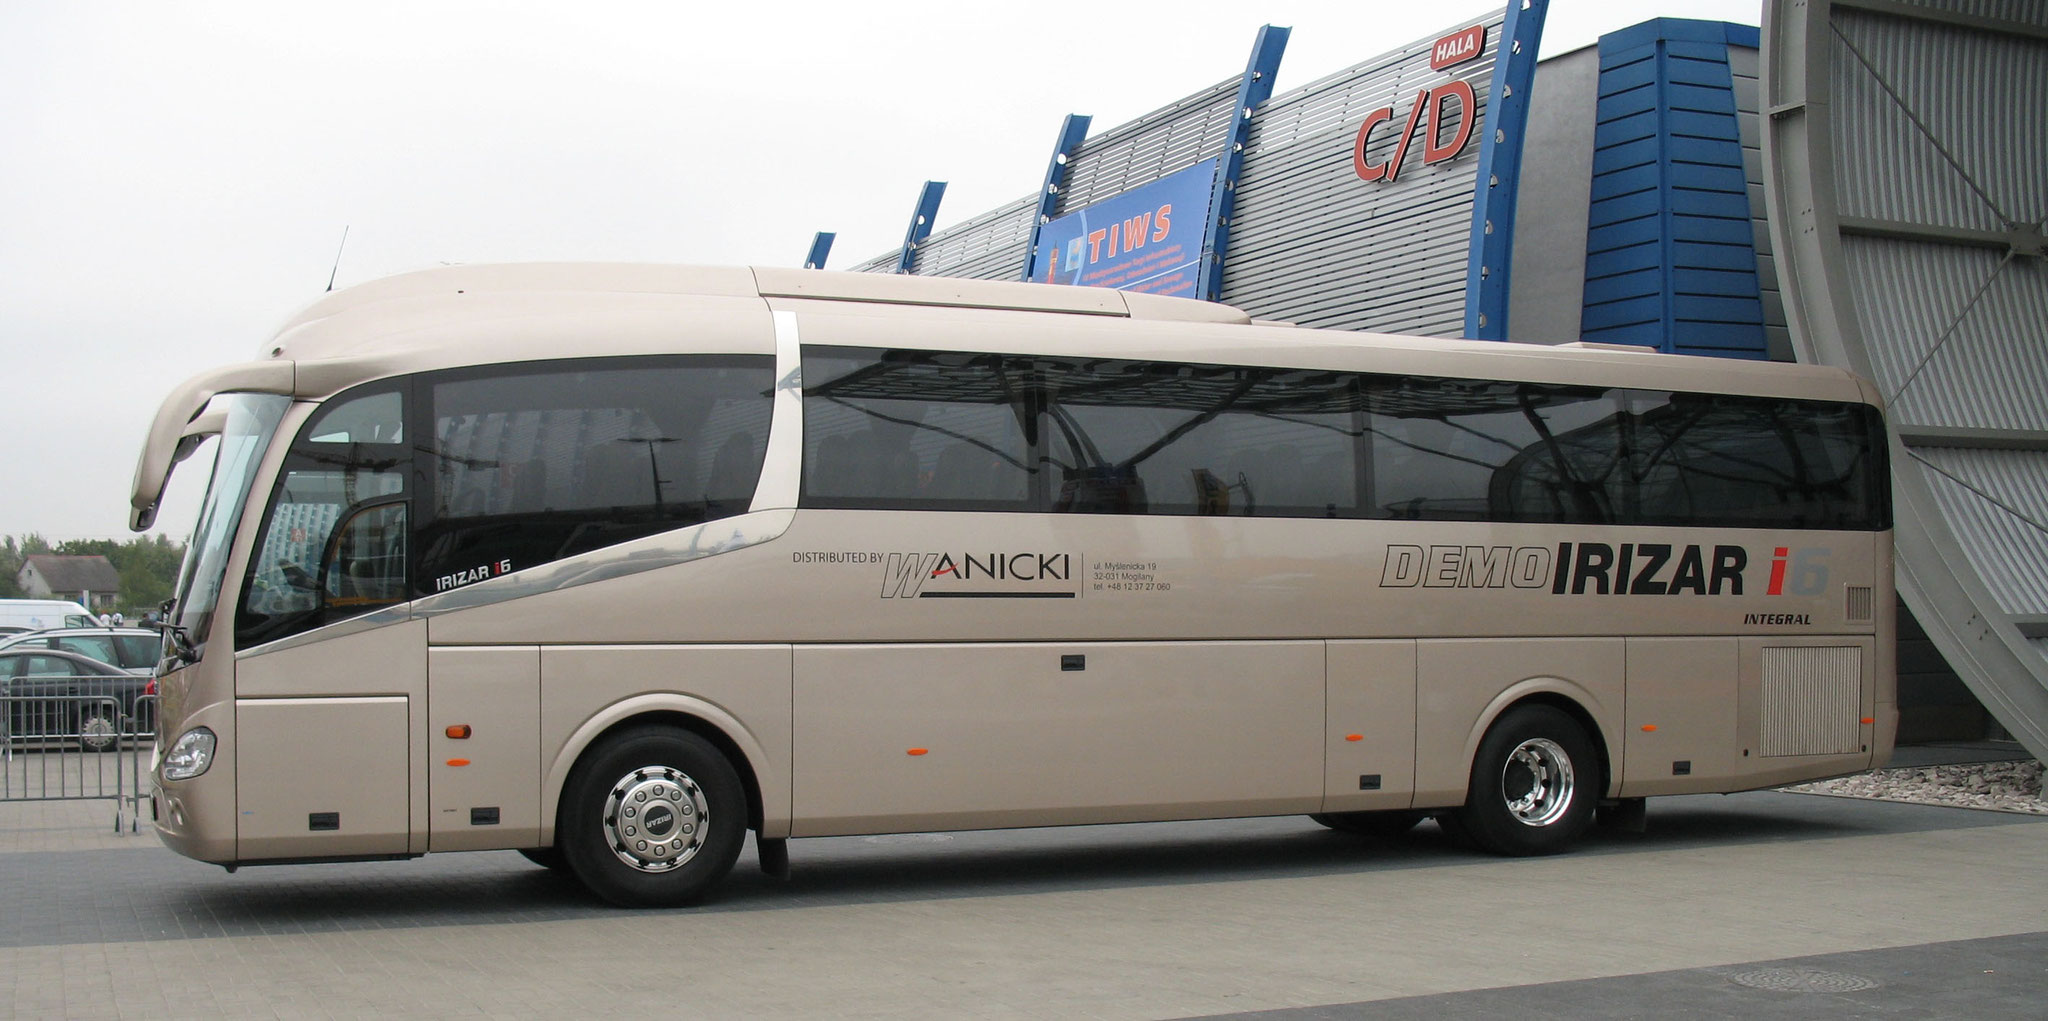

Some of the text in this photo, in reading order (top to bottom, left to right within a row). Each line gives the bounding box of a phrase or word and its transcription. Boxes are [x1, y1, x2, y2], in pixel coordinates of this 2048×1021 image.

[1435, 34, 1475, 63] HALA
[1353, 79, 1476, 182] C/D
[1088, 204, 1172, 264] TIWS
[792, 551, 885, 564] DISTRIBUTED BY
[1148, 562, 1157, 571] 19
[436, 559, 512, 591] IRIZAR i6
[880, 551, 1071, 599] WANICKI
[1094, 572, 1120, 581] 32-031
[1766, 546, 1832, 597] i6
[1107, 583, 1122, 591] +48
[1124, 583, 1133, 591] 12
[1134, 583, 1144, 591] 37
[1145, 583, 1155, 591] 27
[1743, 613, 1812, 626] INTEGRAL
[646, 813, 672, 829] IRIZAR
